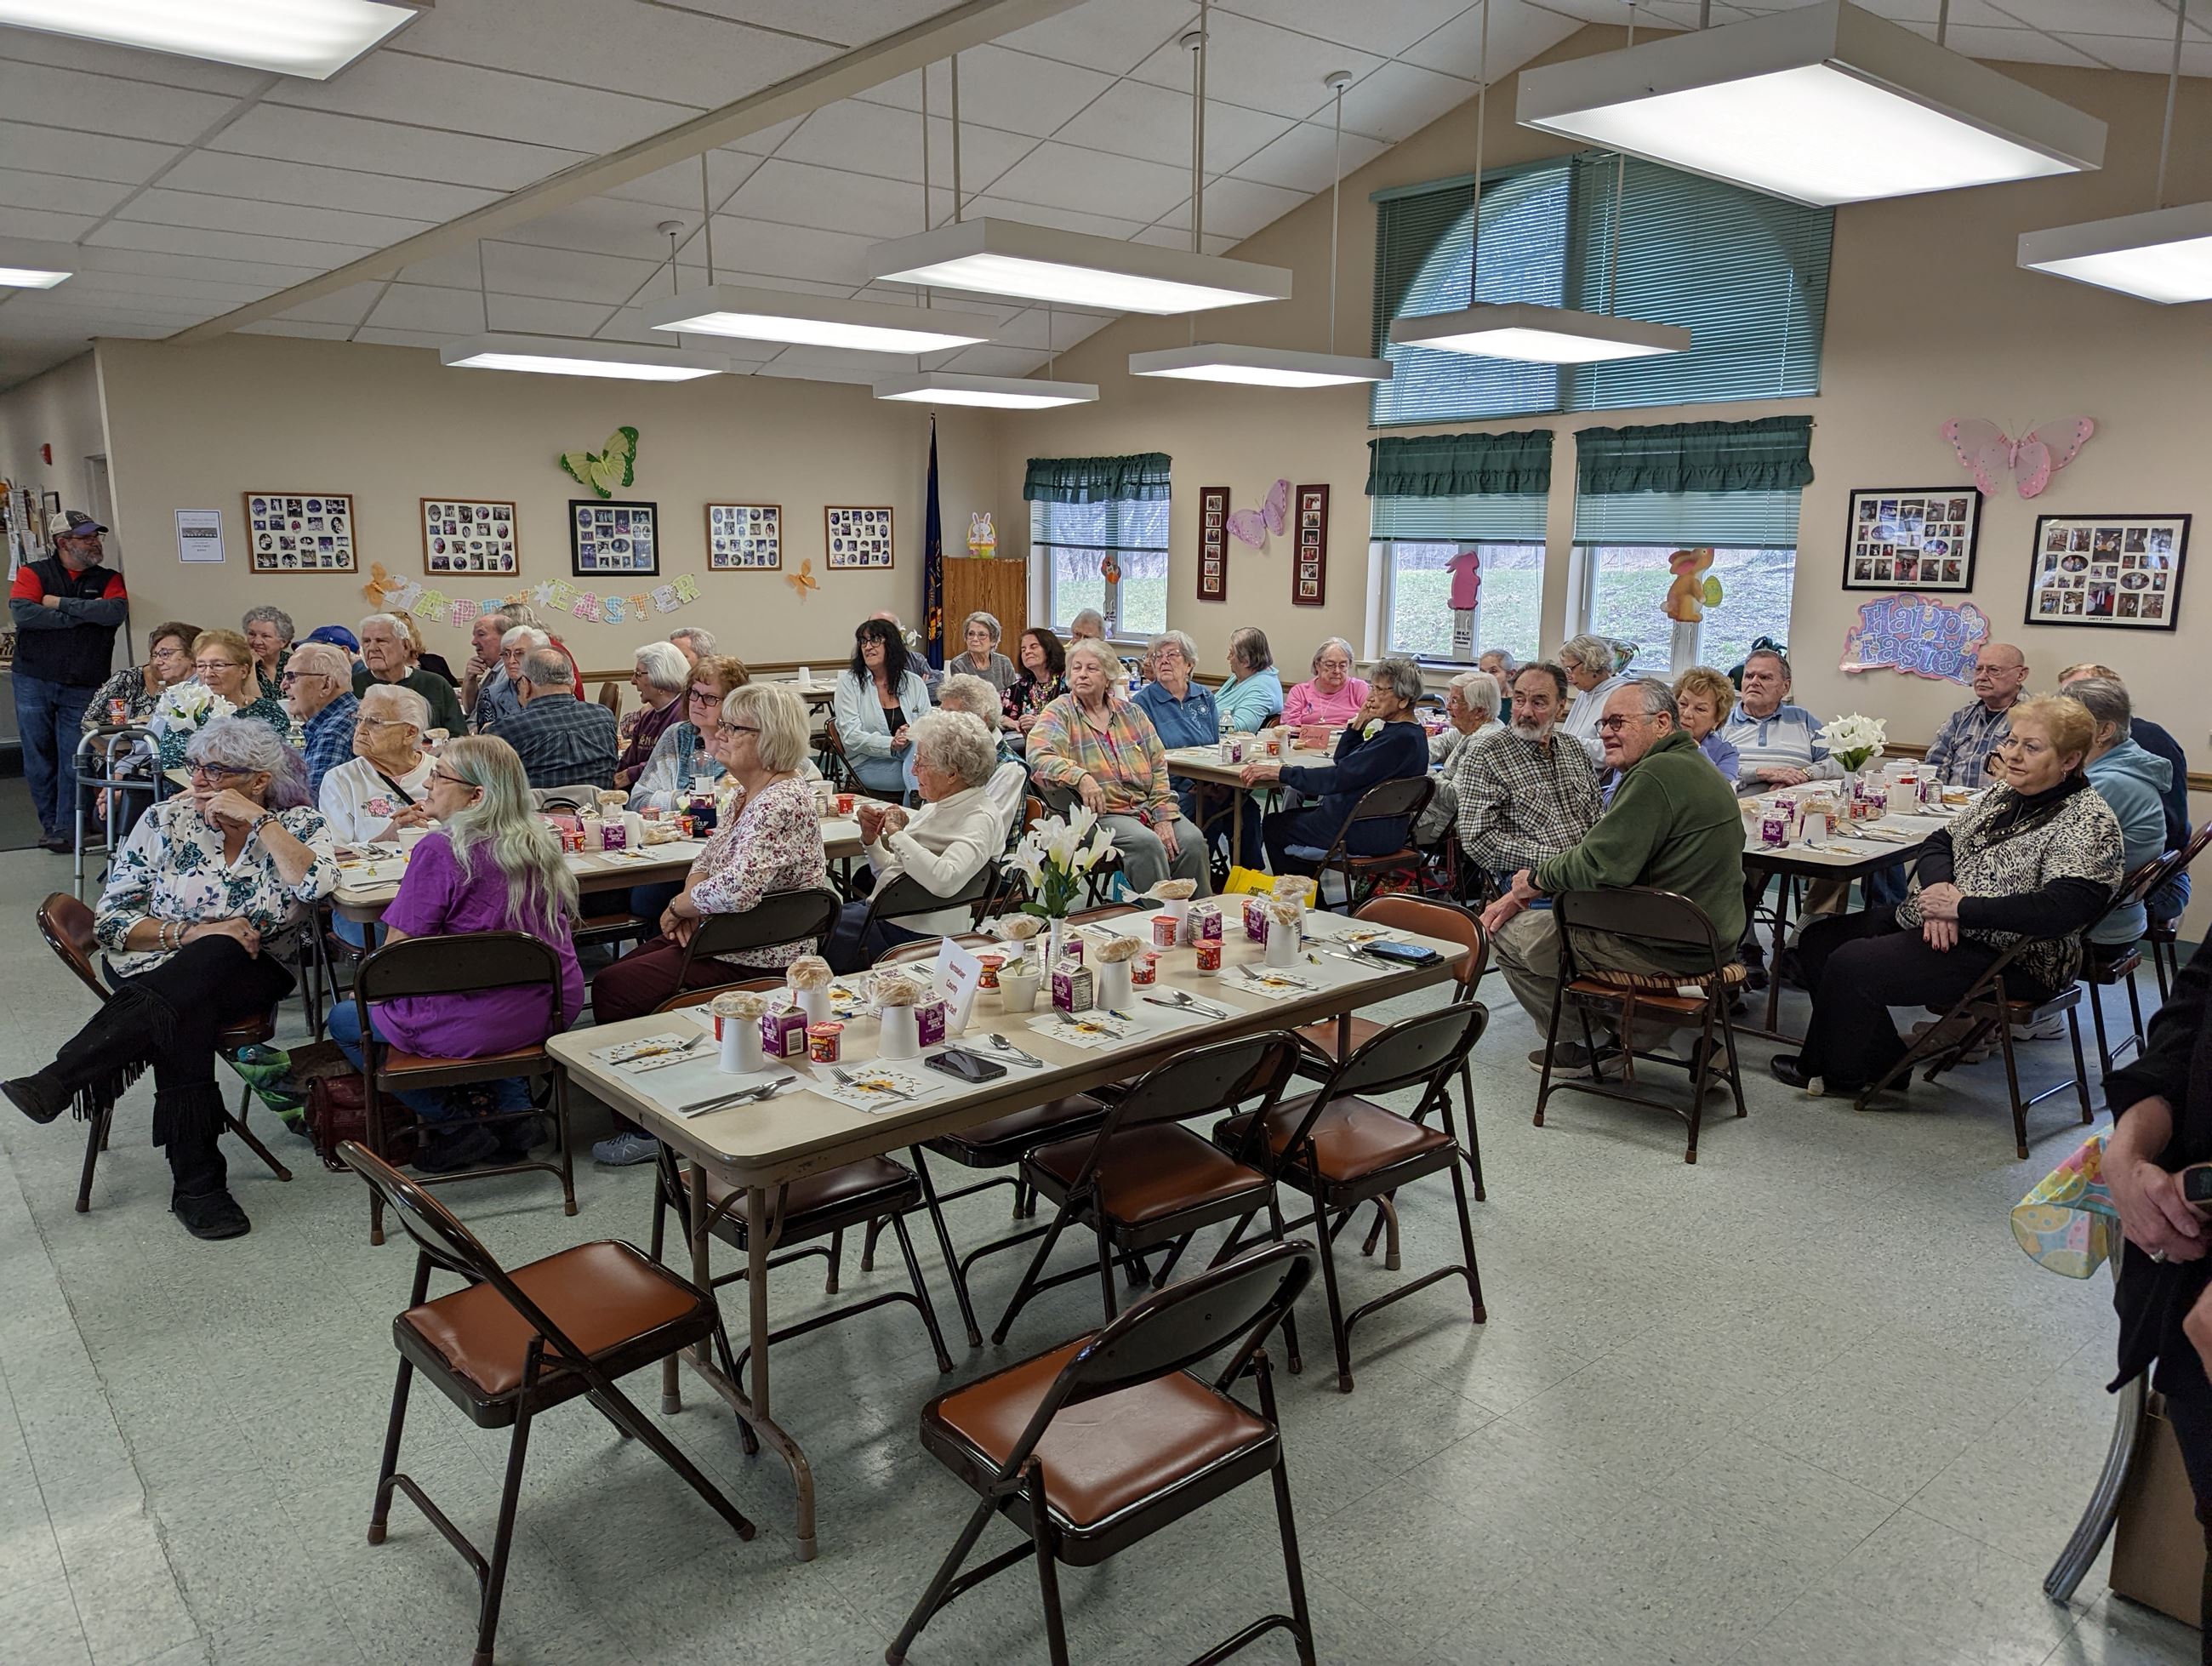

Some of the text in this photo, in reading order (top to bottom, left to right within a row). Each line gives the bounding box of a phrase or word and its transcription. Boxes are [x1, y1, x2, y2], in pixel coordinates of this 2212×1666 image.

[549, 574, 702, 625] EASTER
[1861, 600, 1983, 650] Happy
[1856, 634, 1977, 681] Easter
[945, 978, 959, 996] County
